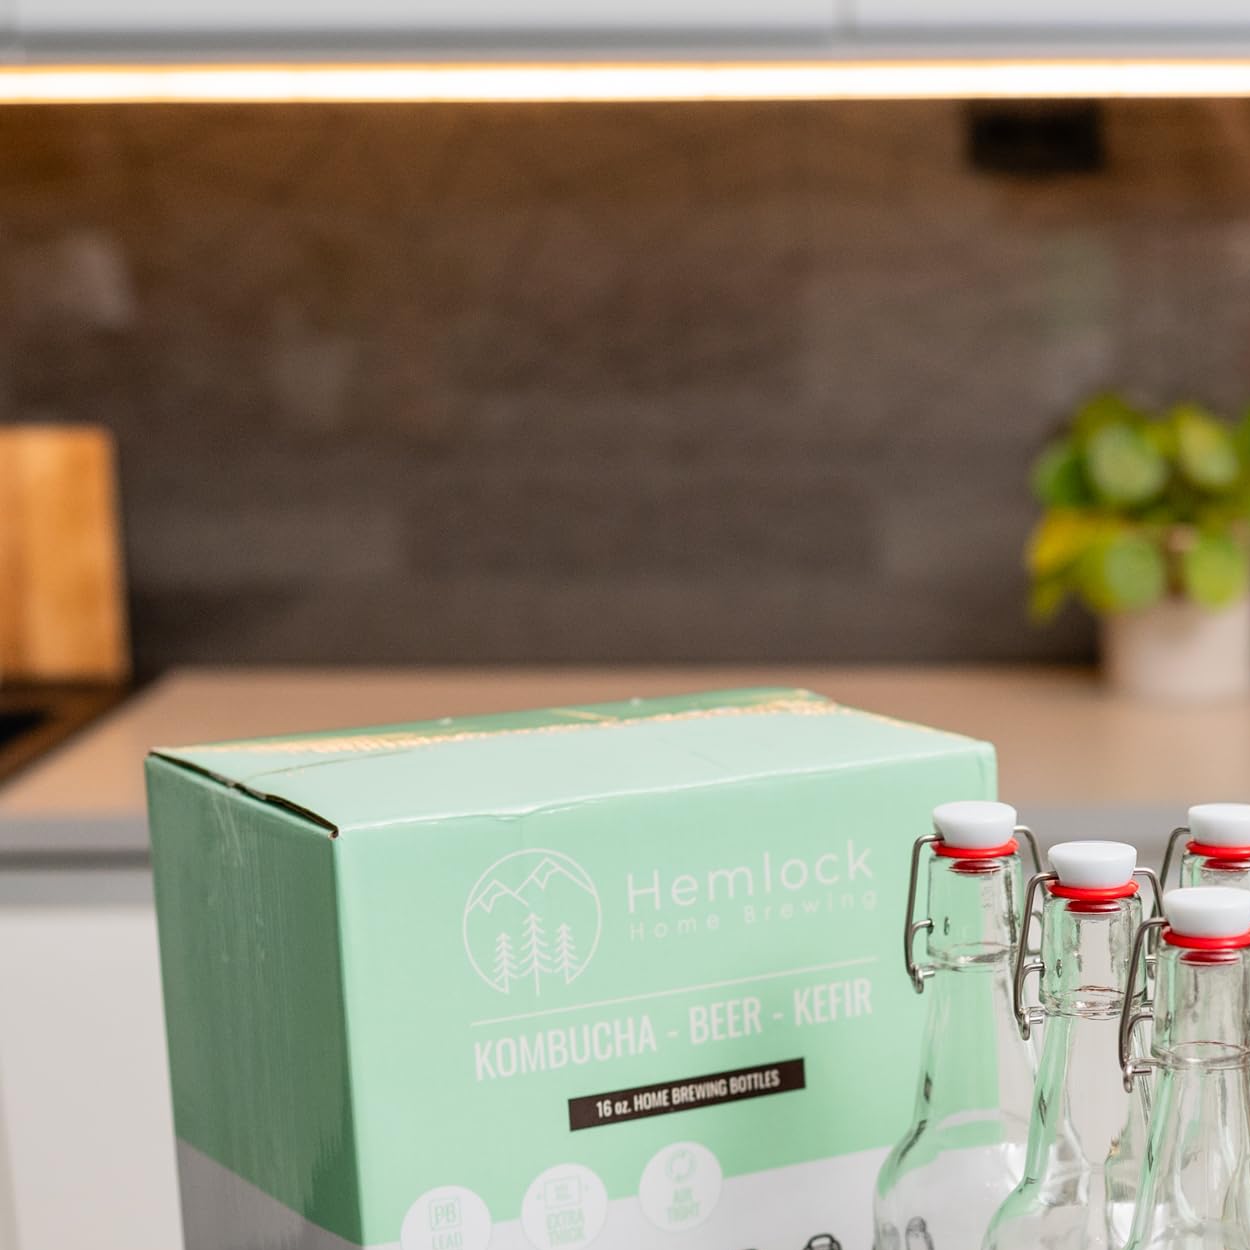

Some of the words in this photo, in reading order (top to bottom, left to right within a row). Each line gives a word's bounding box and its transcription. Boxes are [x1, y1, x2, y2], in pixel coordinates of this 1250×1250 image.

[627, 838, 873, 914] Hemlock
[629, 913, 720, 942] Home
[744, 889, 878, 924] Brewing
[473, 1015, 658, 1081] KOMBUCHA
[689, 996, 762, 1044] BEER
[792, 977, 873, 1027] KEFIR
[596, 1099, 612, 1118] 16
[614, 1101, 632, 1115] oz.
[633, 1089, 670, 1112] HOME
[672, 1079, 727, 1105] BREWING
[729, 1069, 780, 1094] BOTTLES
